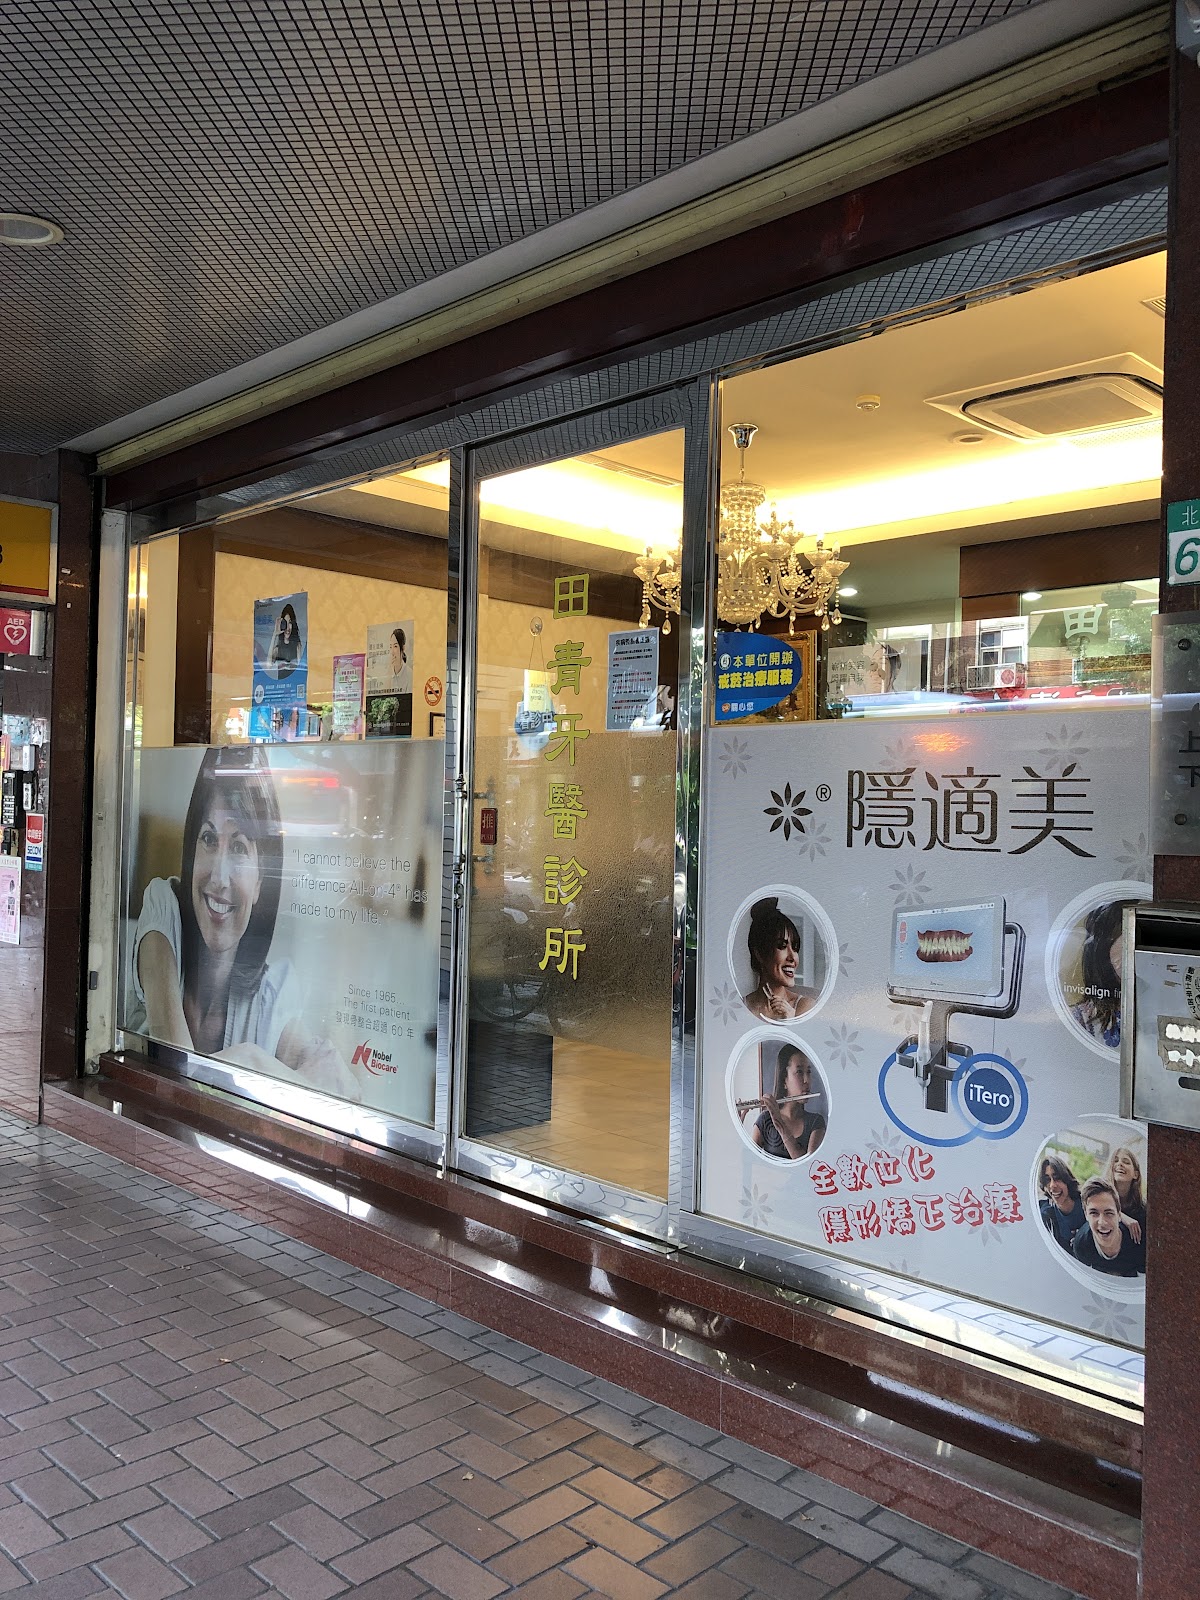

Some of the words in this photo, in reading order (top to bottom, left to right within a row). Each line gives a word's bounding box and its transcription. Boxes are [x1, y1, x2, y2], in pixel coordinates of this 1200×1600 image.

[1181, 505, 1200, 526] 北
[1174, 537, 1200, 576] 6
[7, 617, 25, 626] AED
[733, 651, 793, 668] 本單位開辦
[718, 668, 793, 689] 戒菸治療服務
[538, 572, 593, 981] 田青牙醫診所
[845, 762, 1097, 858] 隱適美
[482, 813, 494, 829] 推
[303, 852, 341, 867] cannot
[345, 853, 386, 871] believe
[391, 856, 411, 872] the
[291, 875, 346, 894] difference
[405, 884, 428, 903] has
[290, 902, 321, 917] made
[324, 904, 336, 918] to
[339, 908, 357, 924] my
[348, 983, 371, 998] Since
[1063, 982, 1110, 999] invisalign
[343, 996, 358, 1009] The
[360, 1000, 376, 1013] first
[379, 1006, 410, 1020] patient
[391, 1024, 403, 1037] 60
[406, 1027, 414, 1039] 年
[372, 1049, 392, 1062] Nobel
[808, 1144, 936, 1196] 全數位化
[817, 1181, 1025, 1245] 隱形矯正治療
